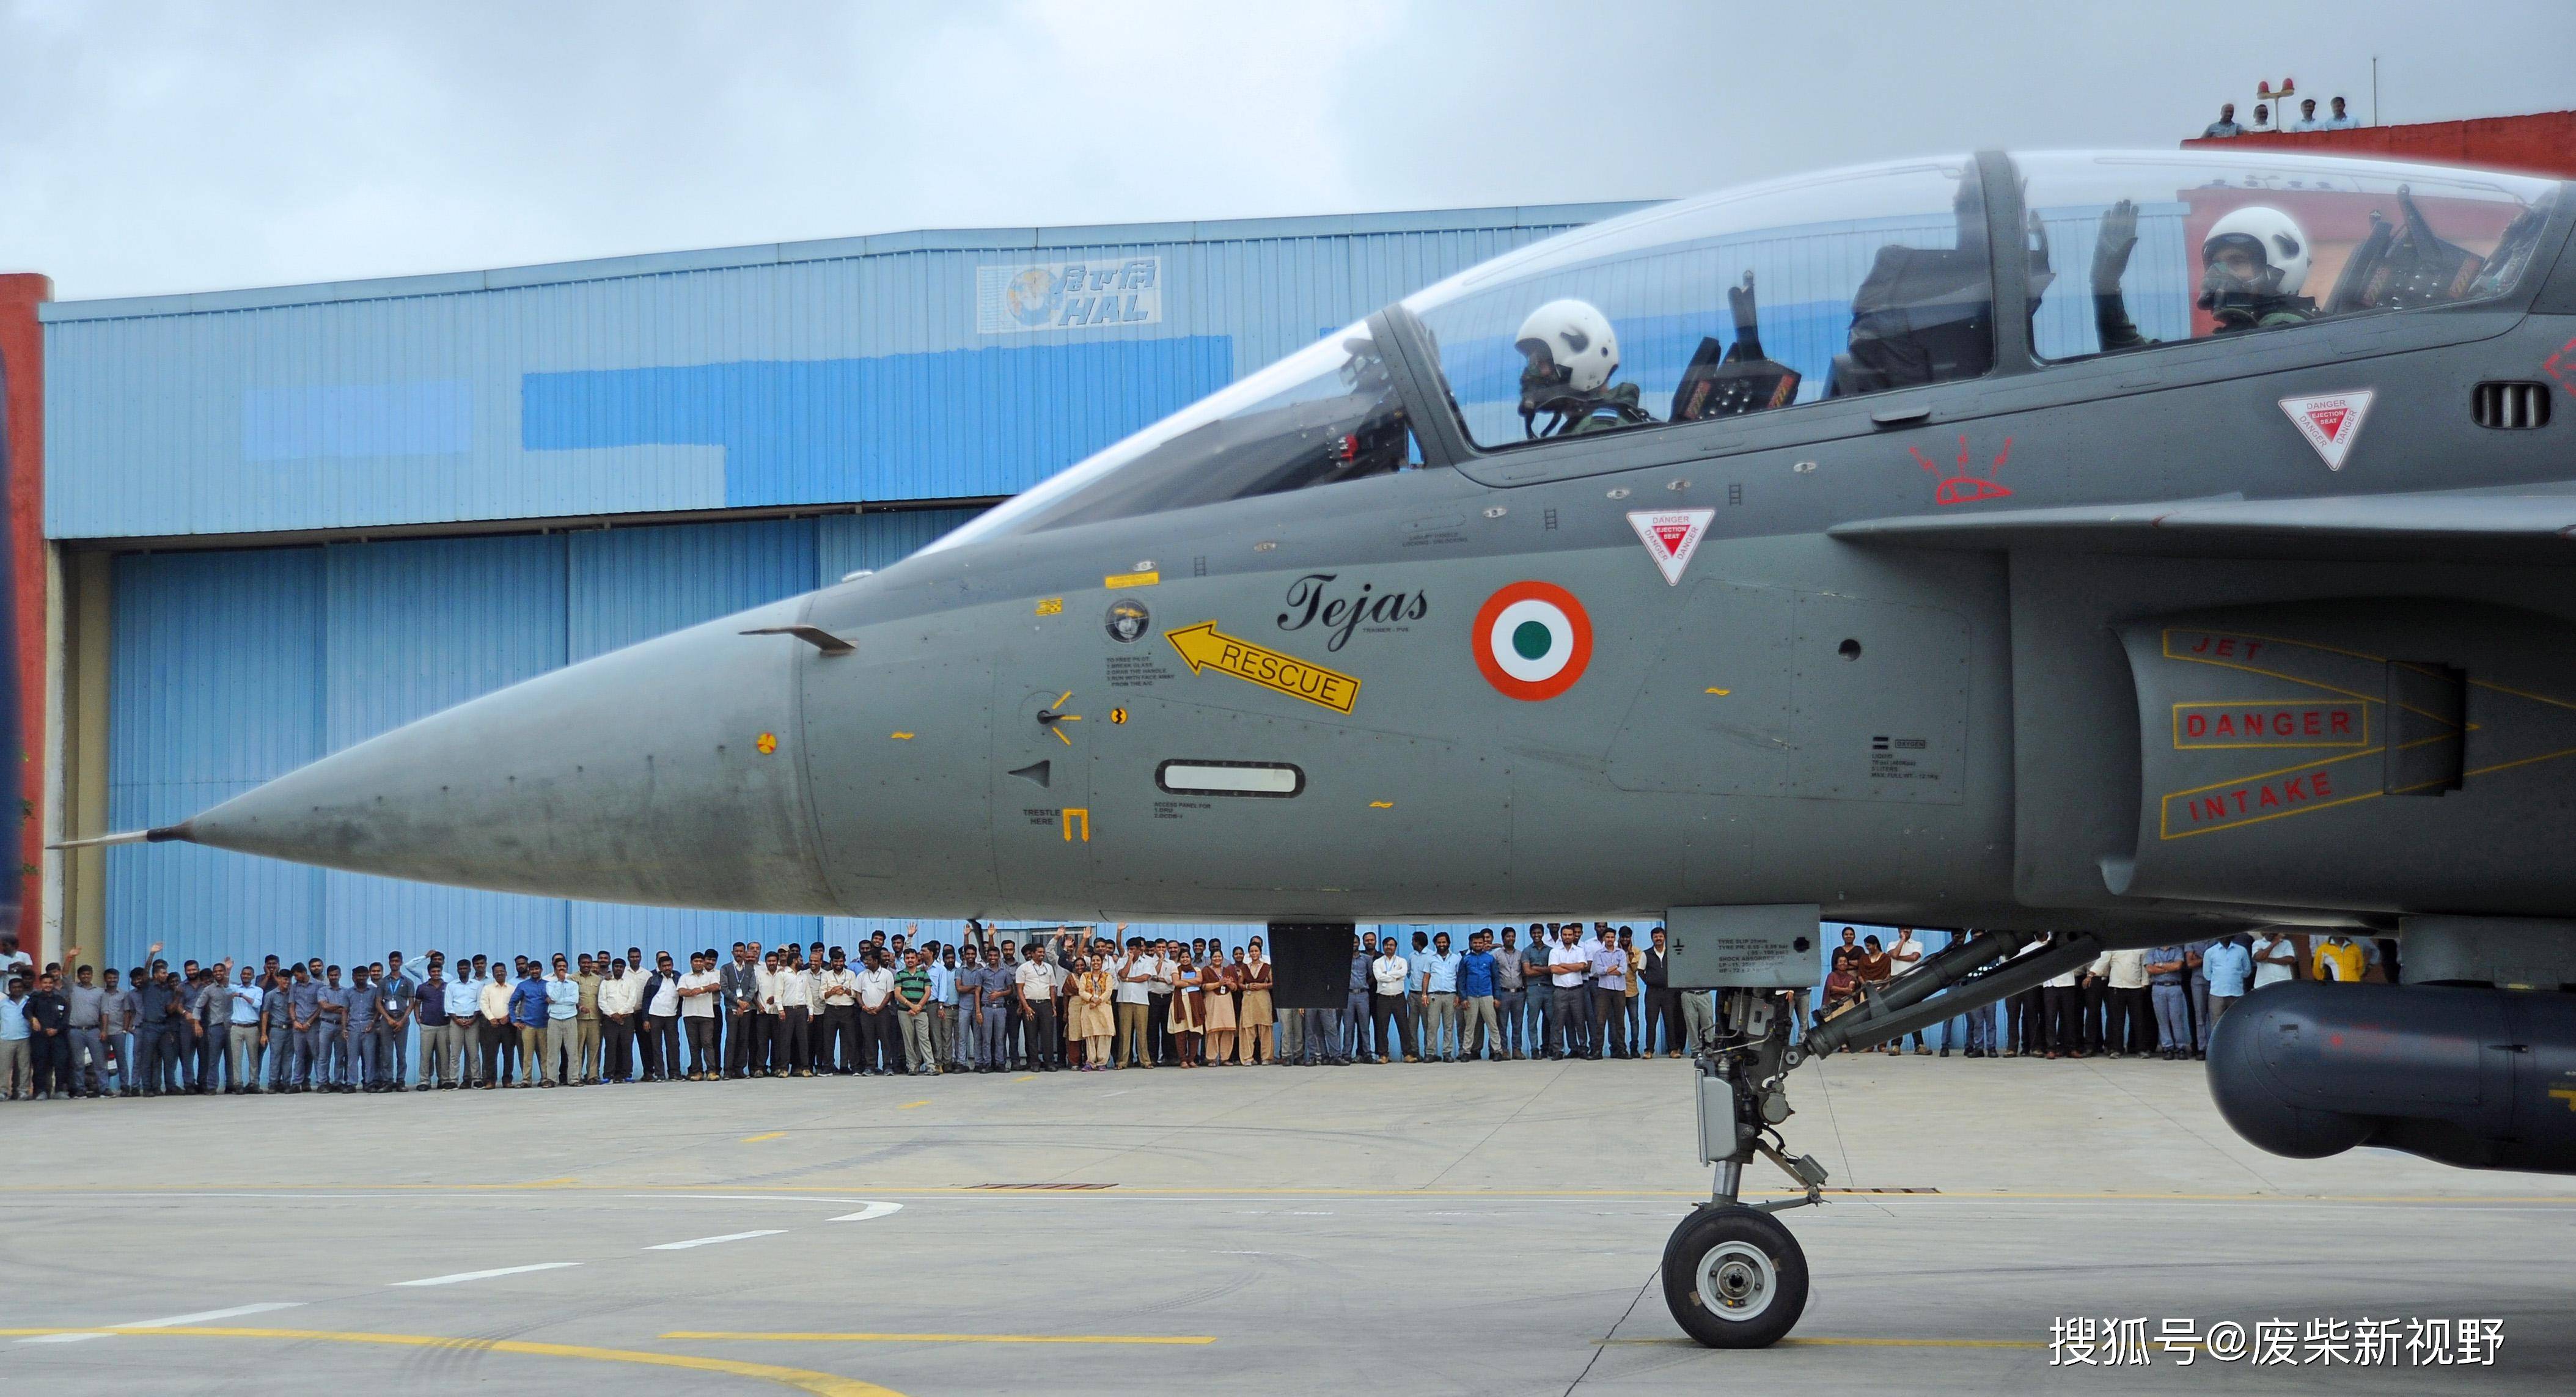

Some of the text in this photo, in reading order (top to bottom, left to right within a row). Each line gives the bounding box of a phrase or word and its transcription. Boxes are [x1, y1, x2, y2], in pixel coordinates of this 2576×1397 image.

[1058, 294, 1148, 326] HAL
[2306, 400, 2346, 409] DANGER
[2299, 416, 2327, 447] DANGER
[2336, 410, 2357, 445] DANGER
[1645, 529, 1668, 562] DANGER
[1676, 527, 1698, 560] DANGER
[1277, 574, 1428, 652] Tejas
[2192, 637, 2262, 660] JET
[1220, 645, 1340, 701] RESCUE
[2187, 710, 2352, 738] DANGER
[2188, 771, 2333, 823] INTAKE
